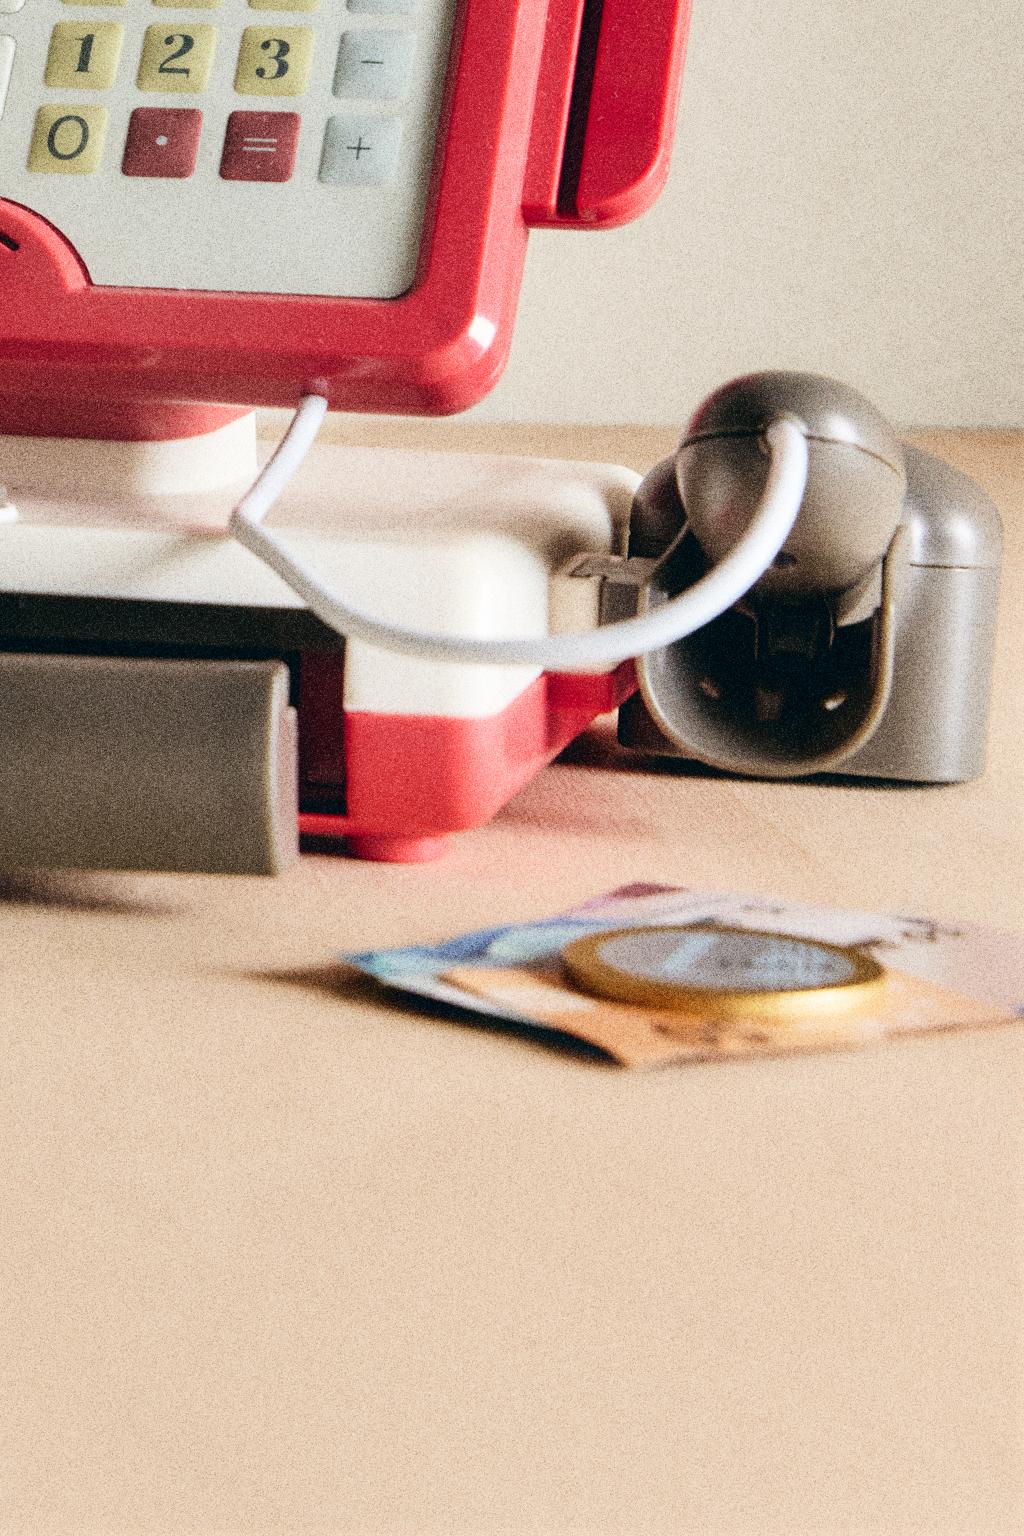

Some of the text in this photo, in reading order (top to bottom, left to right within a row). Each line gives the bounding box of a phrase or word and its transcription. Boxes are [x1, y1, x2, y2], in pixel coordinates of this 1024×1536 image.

[76, 33, 95, 73] 1
[158, 34, 194, 79] 2
[255, 38, 290, 80] 3
[47, 115, 89, 161] 0
